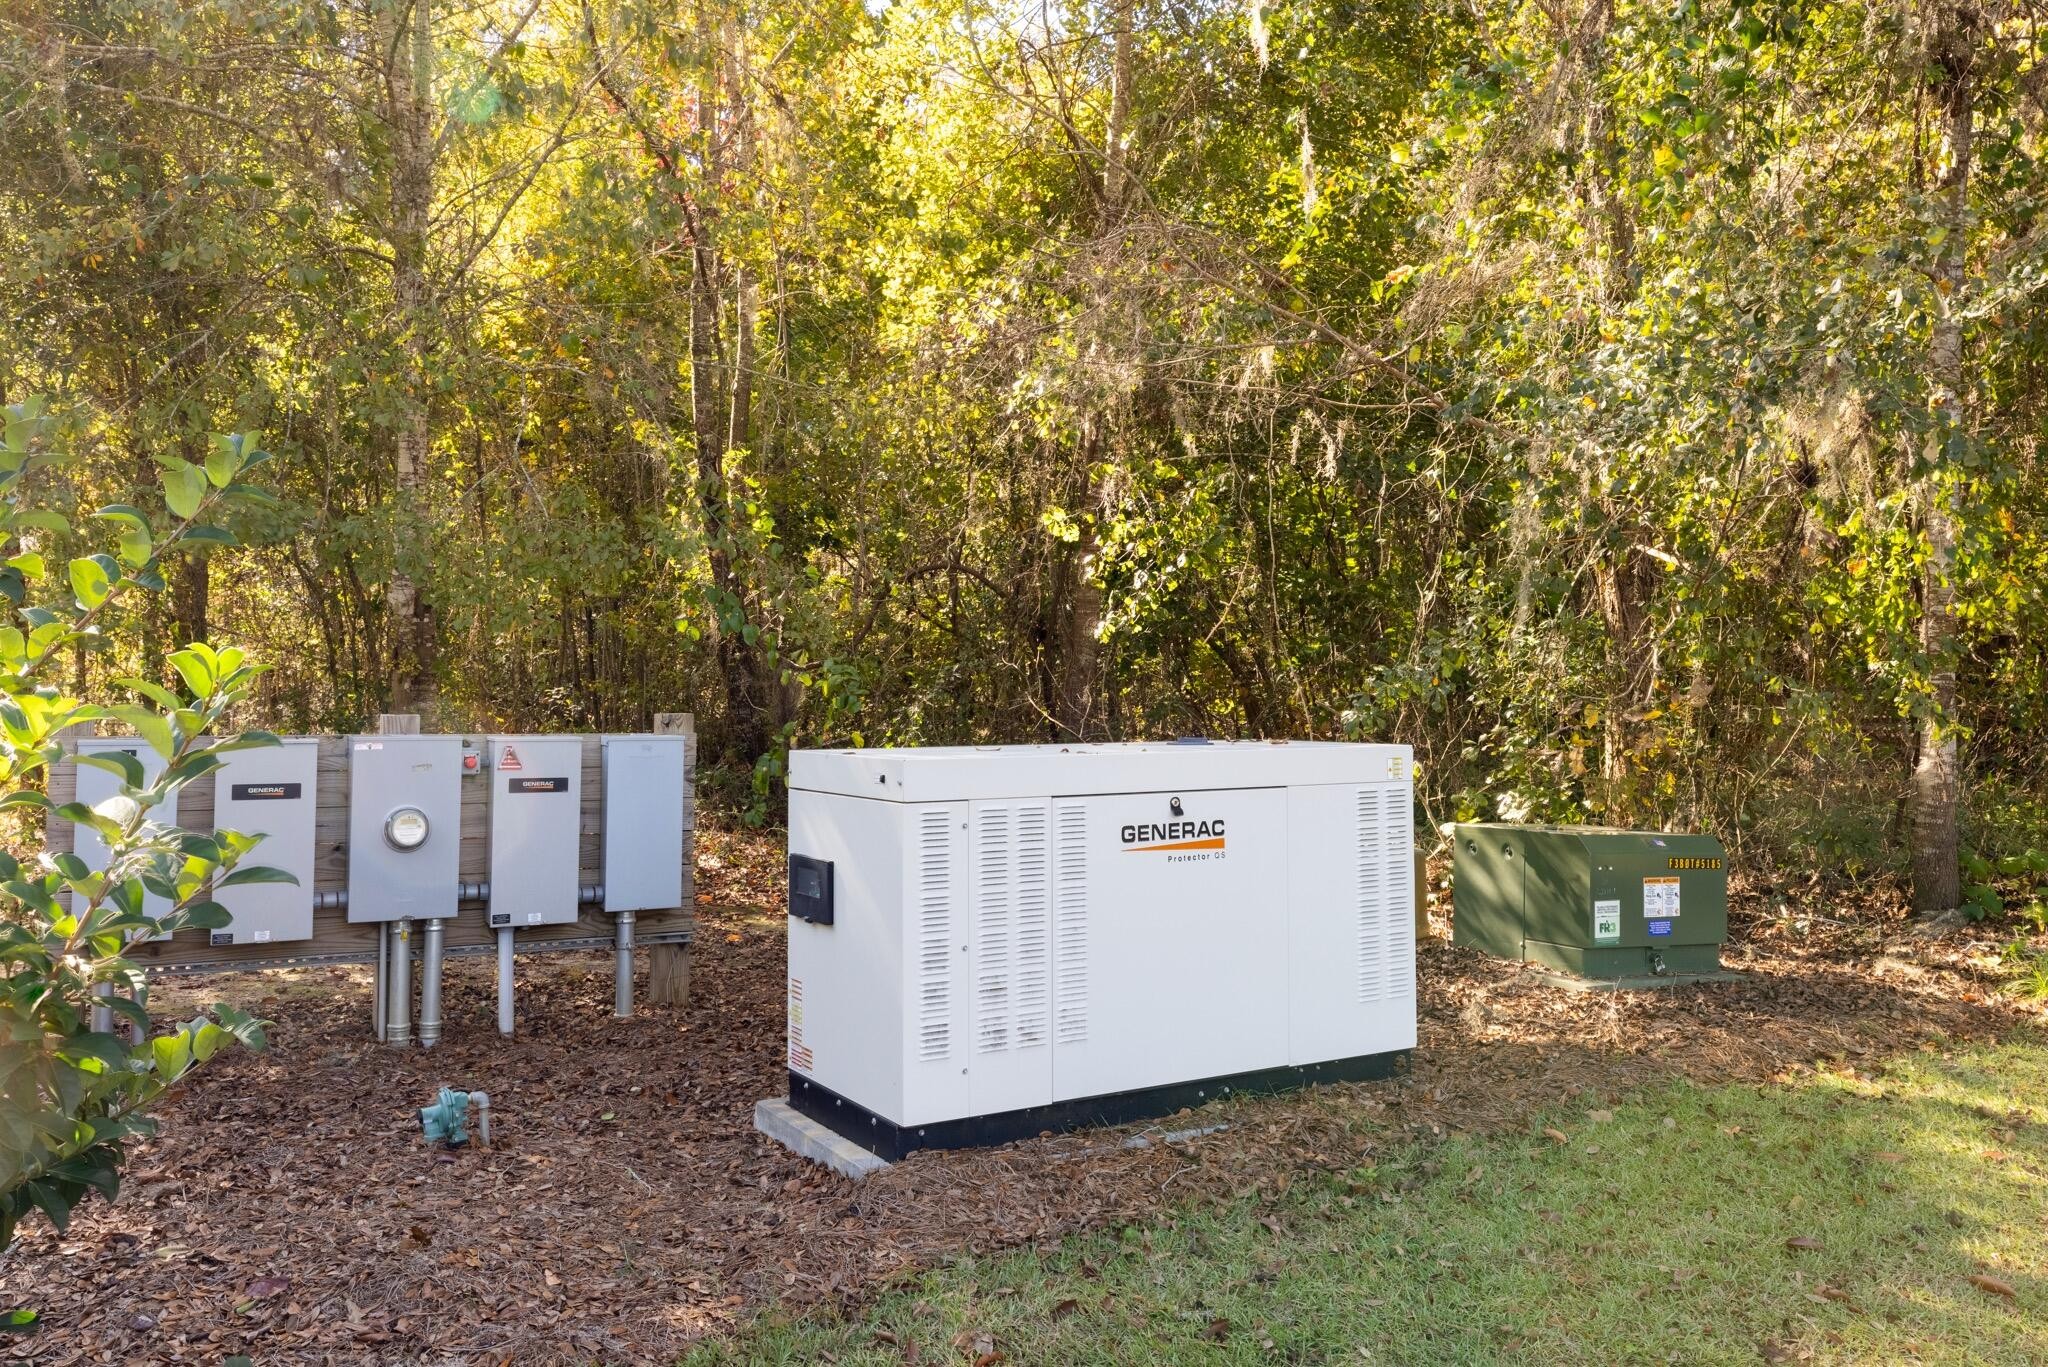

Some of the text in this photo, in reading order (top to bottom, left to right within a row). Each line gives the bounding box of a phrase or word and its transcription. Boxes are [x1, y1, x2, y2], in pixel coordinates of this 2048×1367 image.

[1121, 819, 1225, 843] GENERAC
[1168, 851, 1226, 863] Protector QS
[1599, 922, 1617, 933] FR3
